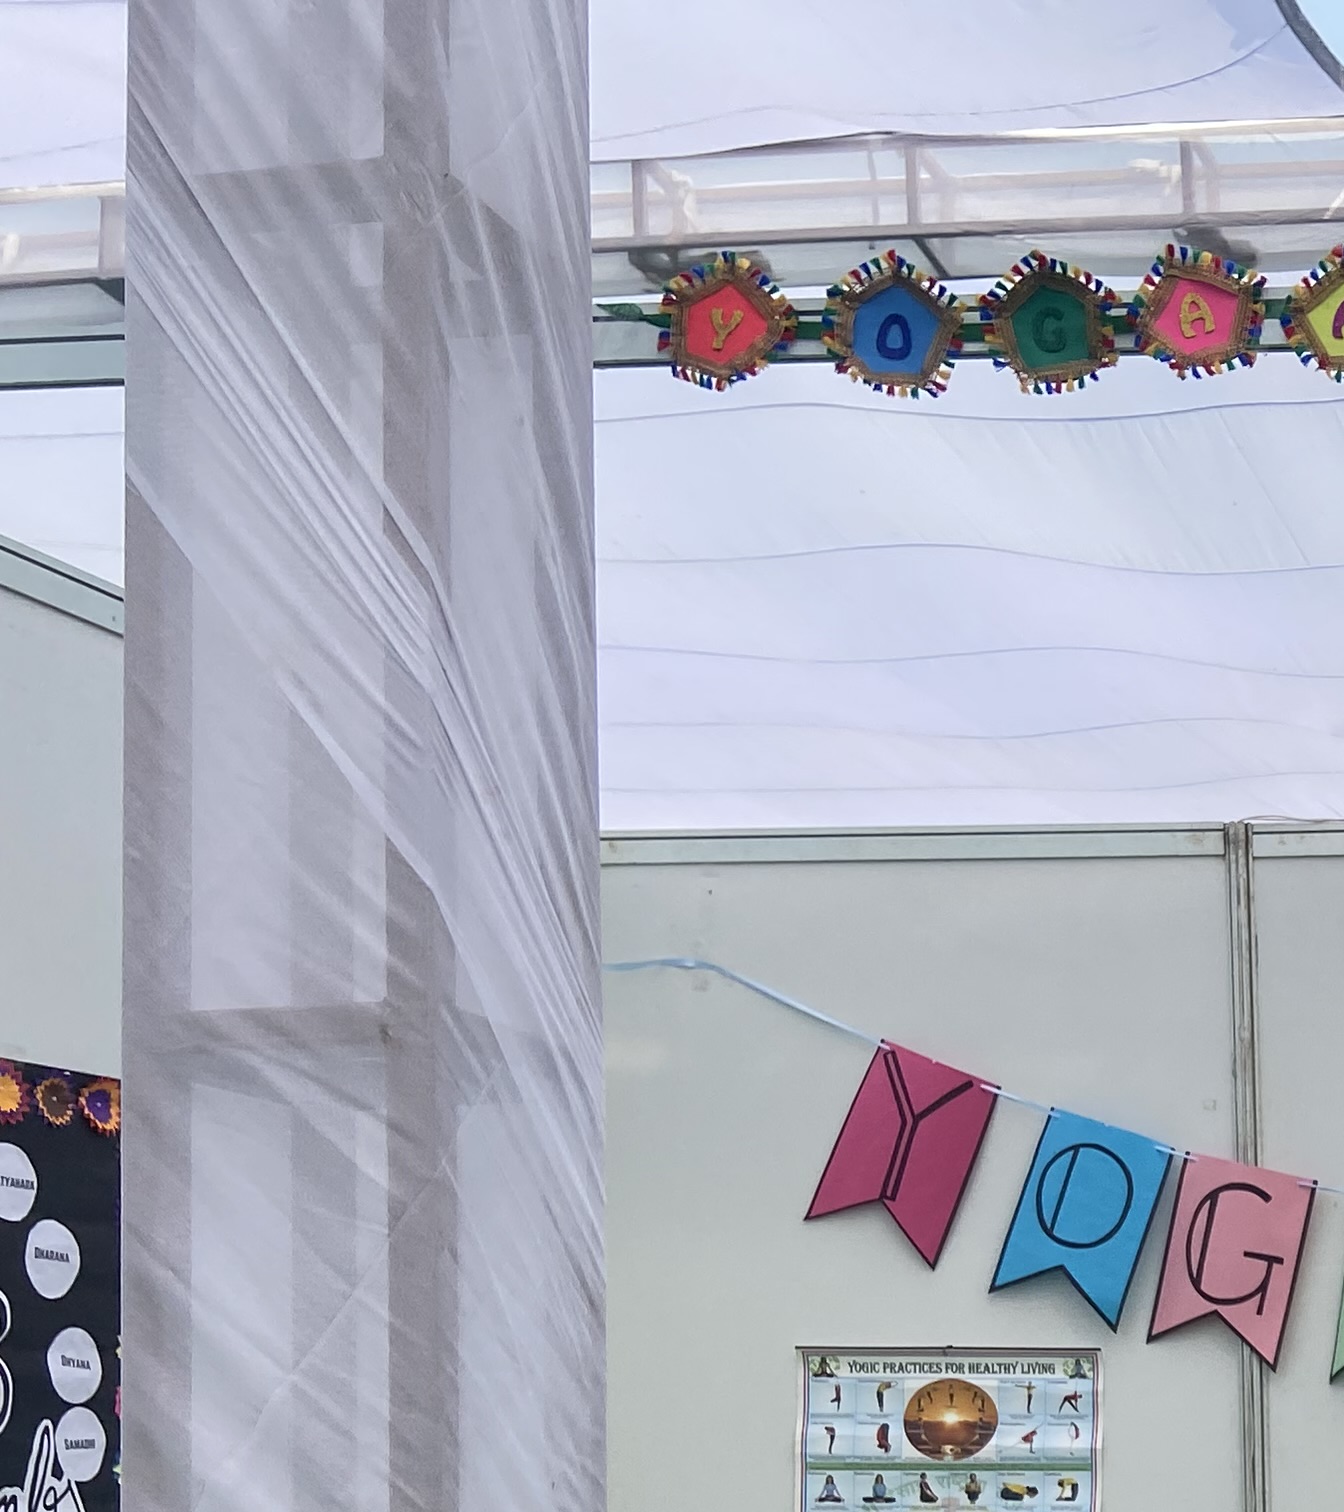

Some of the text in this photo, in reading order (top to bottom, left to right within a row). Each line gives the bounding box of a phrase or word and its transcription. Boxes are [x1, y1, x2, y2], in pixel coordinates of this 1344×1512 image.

[847, 1361, 1056, 1375] YOGIC PRACTICES FOR HEALTHY LIVING
